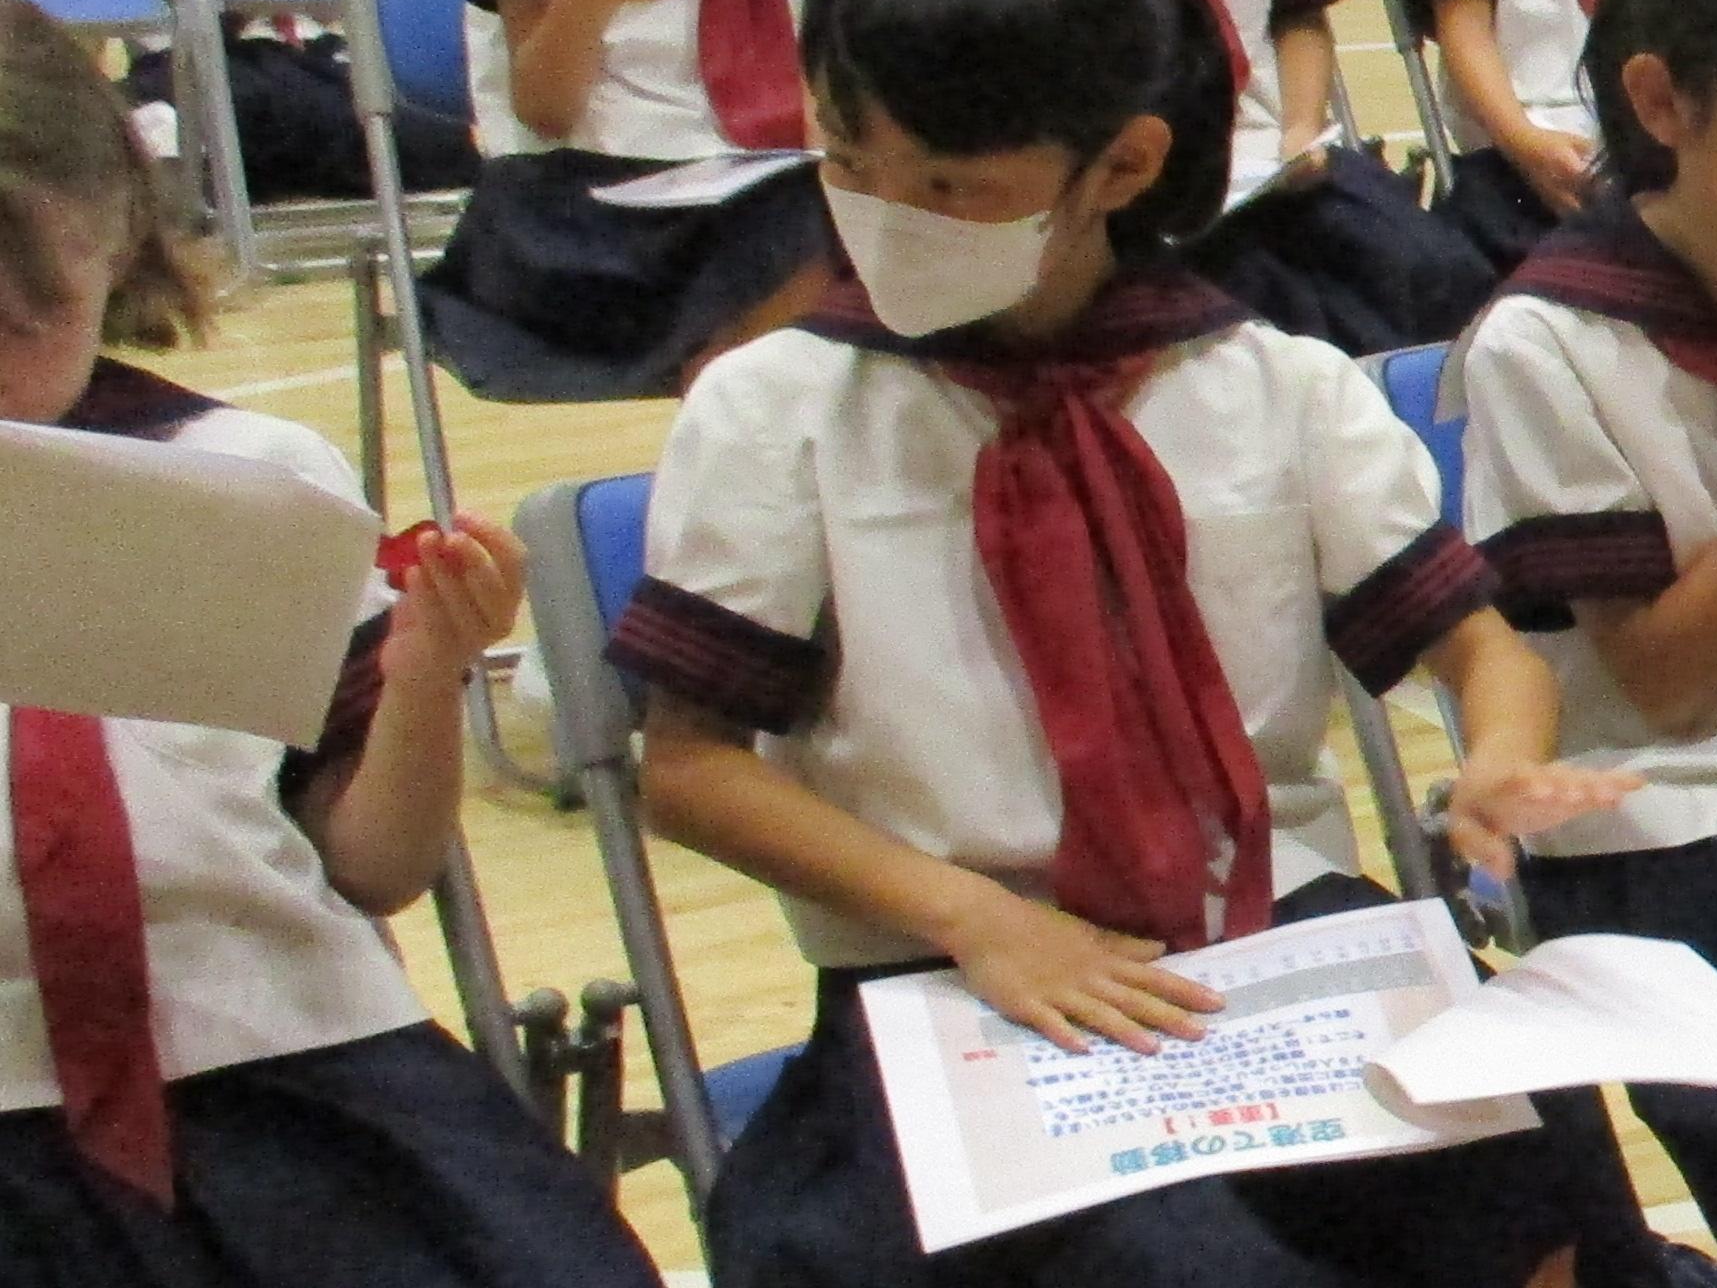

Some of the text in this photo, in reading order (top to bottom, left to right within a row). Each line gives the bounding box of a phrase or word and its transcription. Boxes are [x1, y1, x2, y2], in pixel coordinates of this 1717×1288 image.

[1110, 1118, 1347, 1176] 空港での移動
